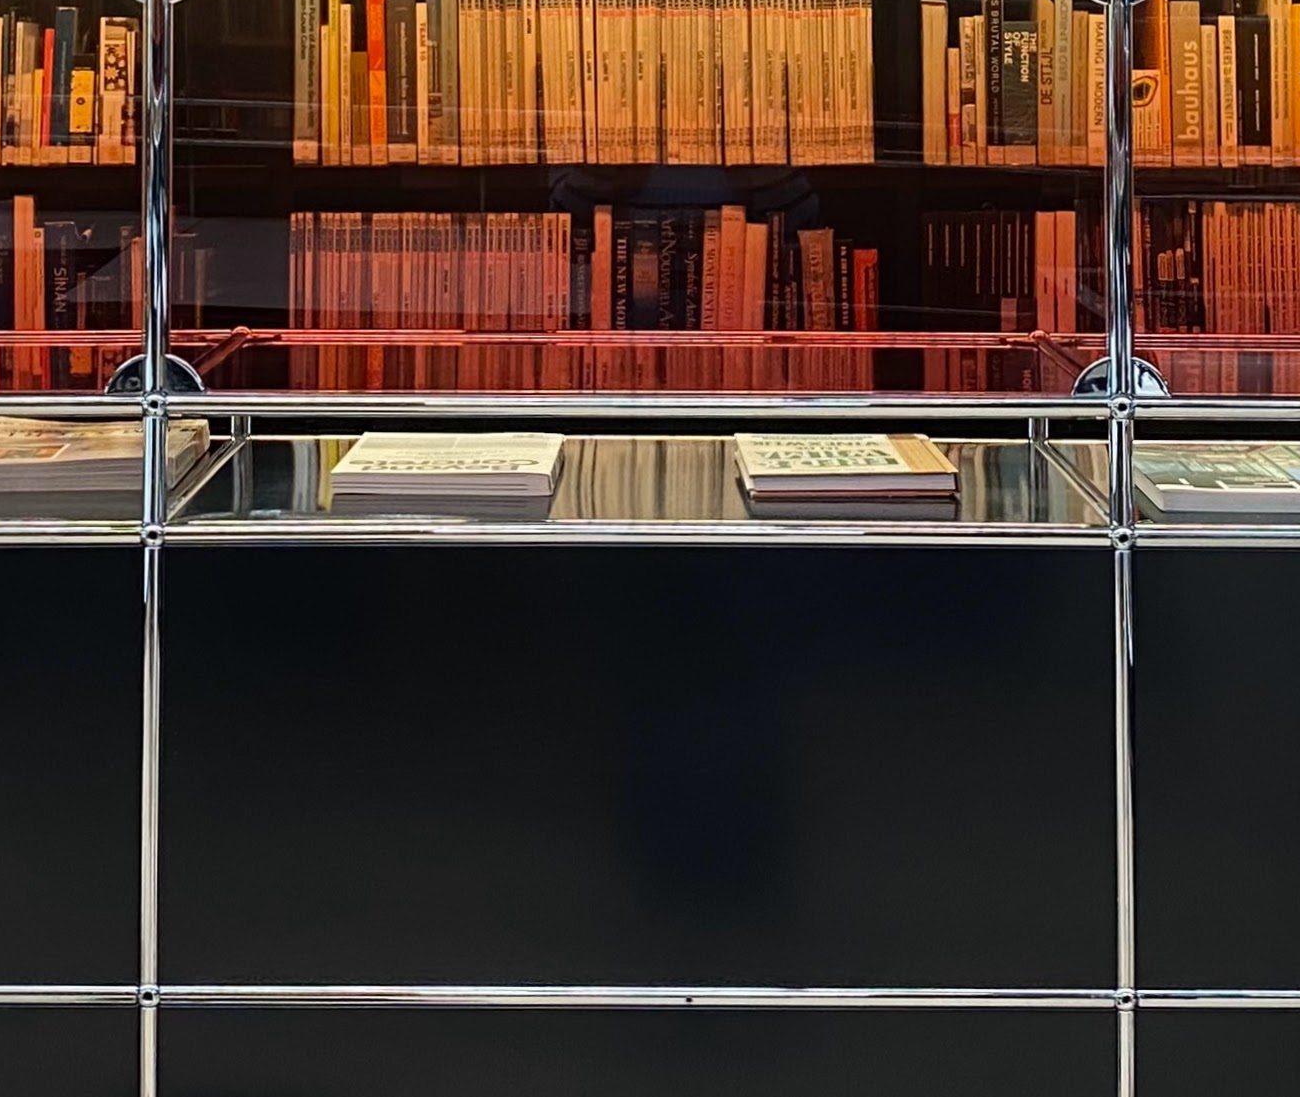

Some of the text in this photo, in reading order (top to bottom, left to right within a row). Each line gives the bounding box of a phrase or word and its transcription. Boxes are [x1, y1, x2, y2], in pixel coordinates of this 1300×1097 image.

[991, 10, 1000, 53] BRUTAL
[1004, 31, 1013, 65] STYLE
[1013, 31, 1021, 47] OF
[1029, 31, 1038, 53] THE
[420, 50, 427, 62] 10
[991, 55, 1000, 93] WORLD
[1020, 31, 1029, 83] FUNCTION
[1041, 47, 1053, 105] DE STIJL
[1094, 21, 1105, 127] MAKING IT MODERN
[1223, 29, 1234, 119] BROKERS MODERNITY
[1180, 40, 1201, 140] bauhaus
[616, 238, 628, 295] THE NEW
[660, 212, 677, 306] Art Nouveau
[54, 266, 69, 314] SINAN
[348, 458, 540, 468] Concrete
